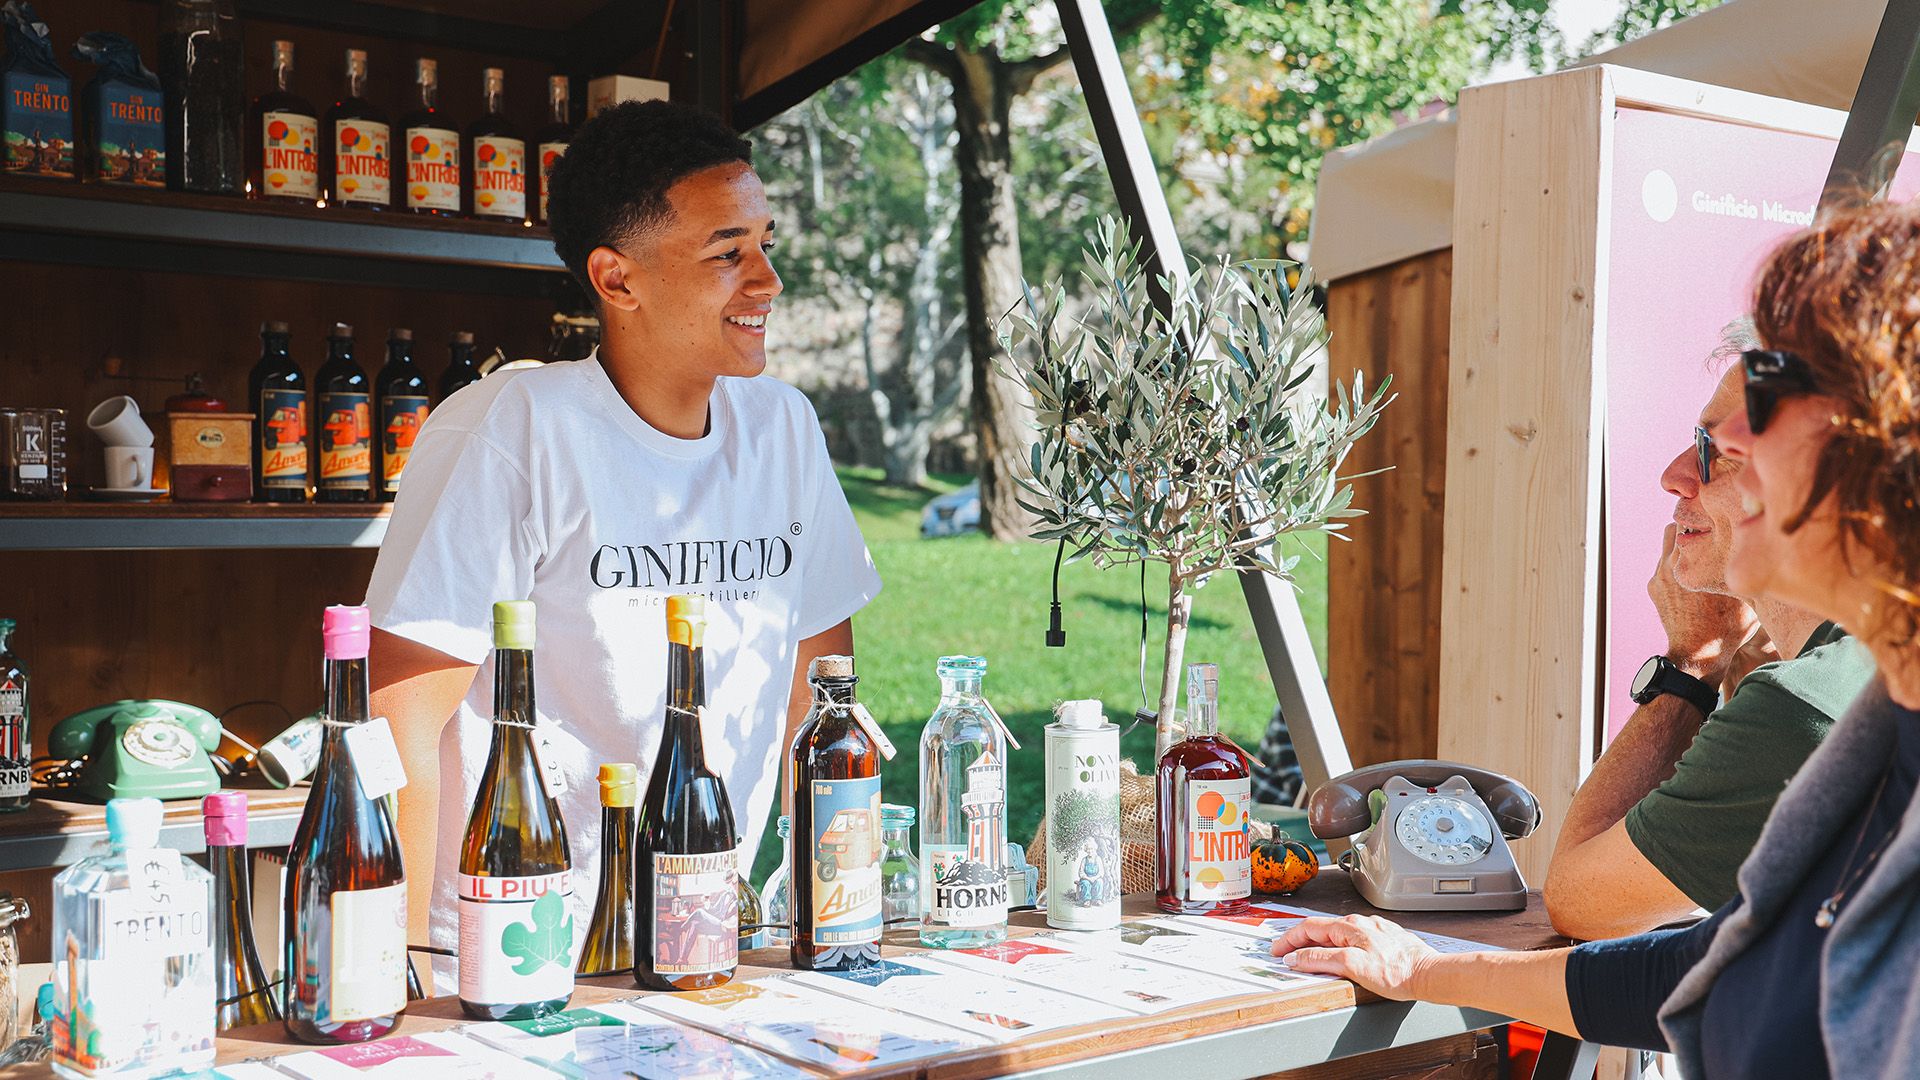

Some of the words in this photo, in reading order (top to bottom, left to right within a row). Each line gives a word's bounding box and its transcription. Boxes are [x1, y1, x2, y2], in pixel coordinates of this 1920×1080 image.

[34, 83, 49, 93] GIN
[14, 89, 70, 113] TRENTO
[111, 101, 163, 124] TRENTO
[1692, 190, 1758, 219] Ginificio
[26, 433, 39, 451] K
[589, 535, 793, 589] GINIFICIO
[472, 878, 492, 898] IL
[114, 911, 202, 942] TRENTO
